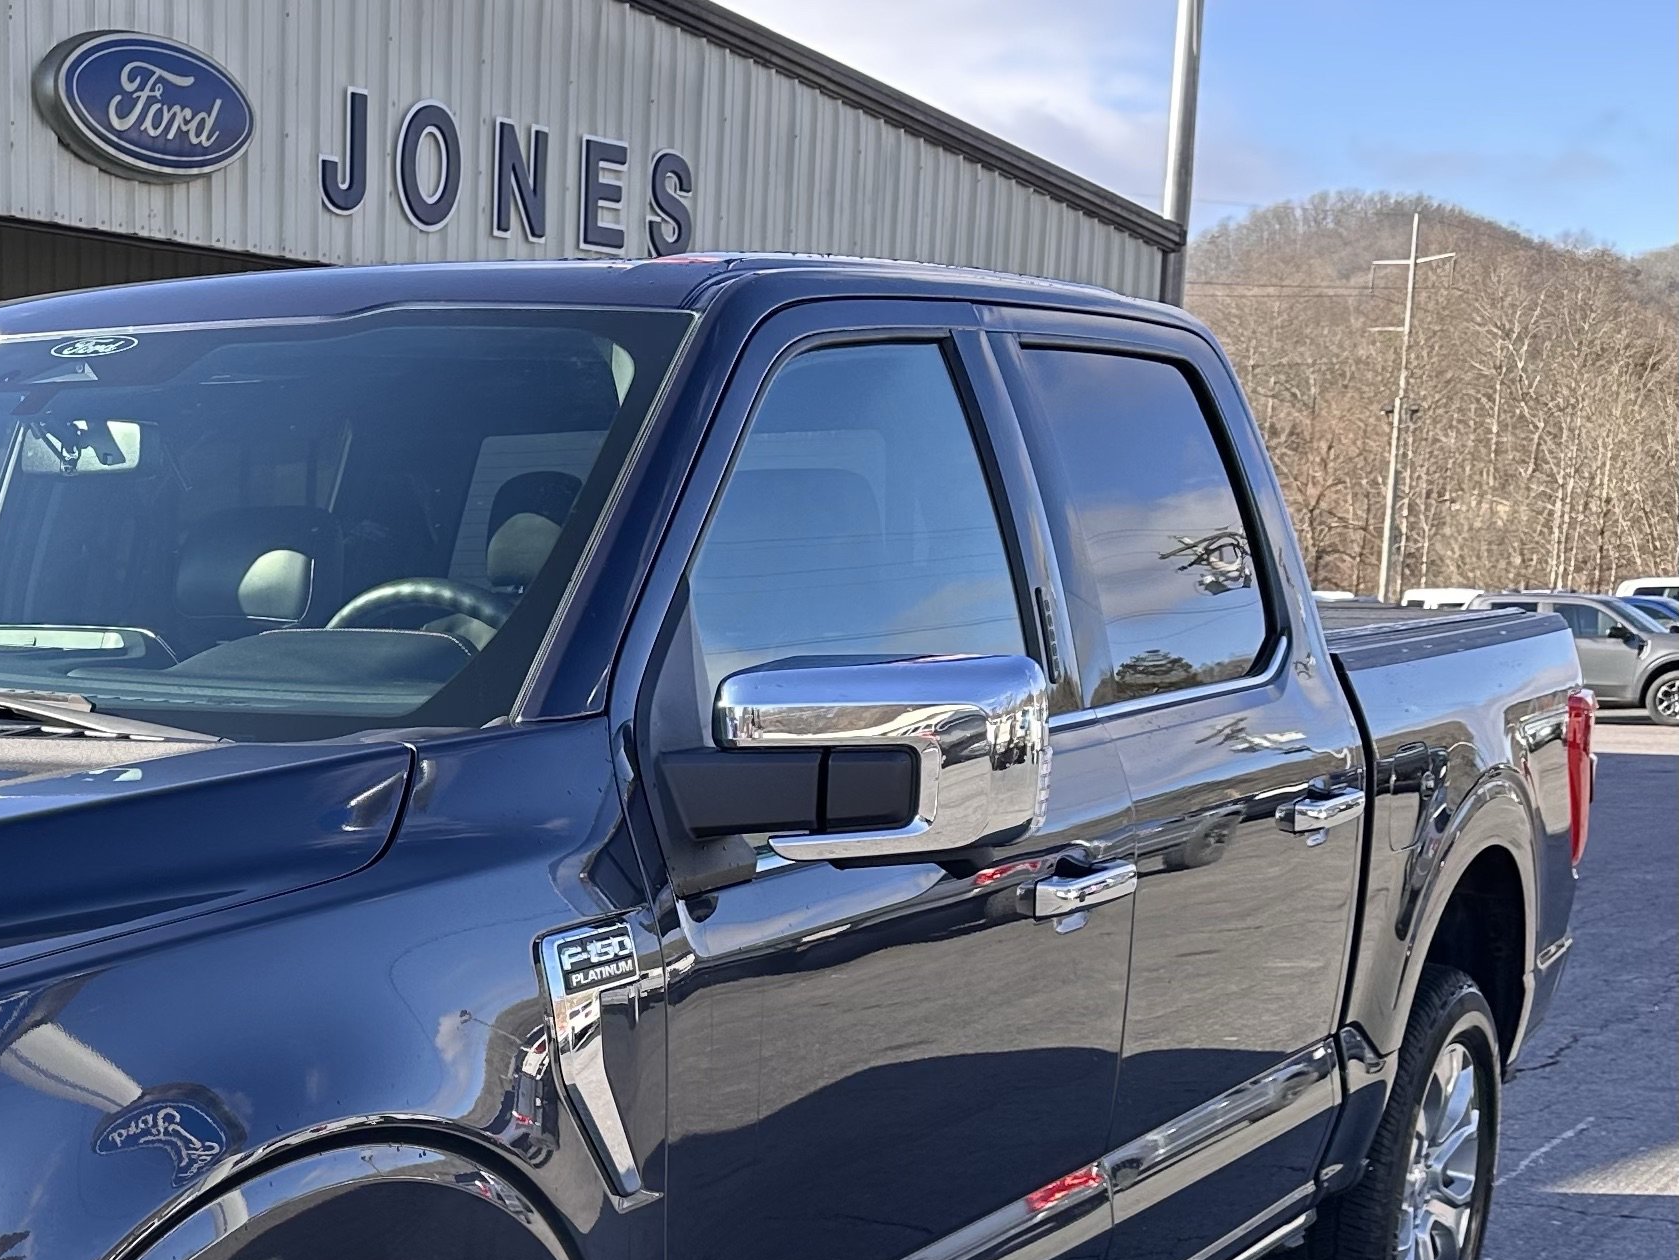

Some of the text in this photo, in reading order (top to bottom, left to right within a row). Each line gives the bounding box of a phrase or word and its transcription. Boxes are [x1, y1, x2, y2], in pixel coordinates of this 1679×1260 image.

[108, 61, 222, 147] Ford
[319, 86, 693, 257] JONES
[62, 339, 126, 355] Ford
[560, 935, 634, 970] F-150
[571, 959, 634, 987] PLATINUM
